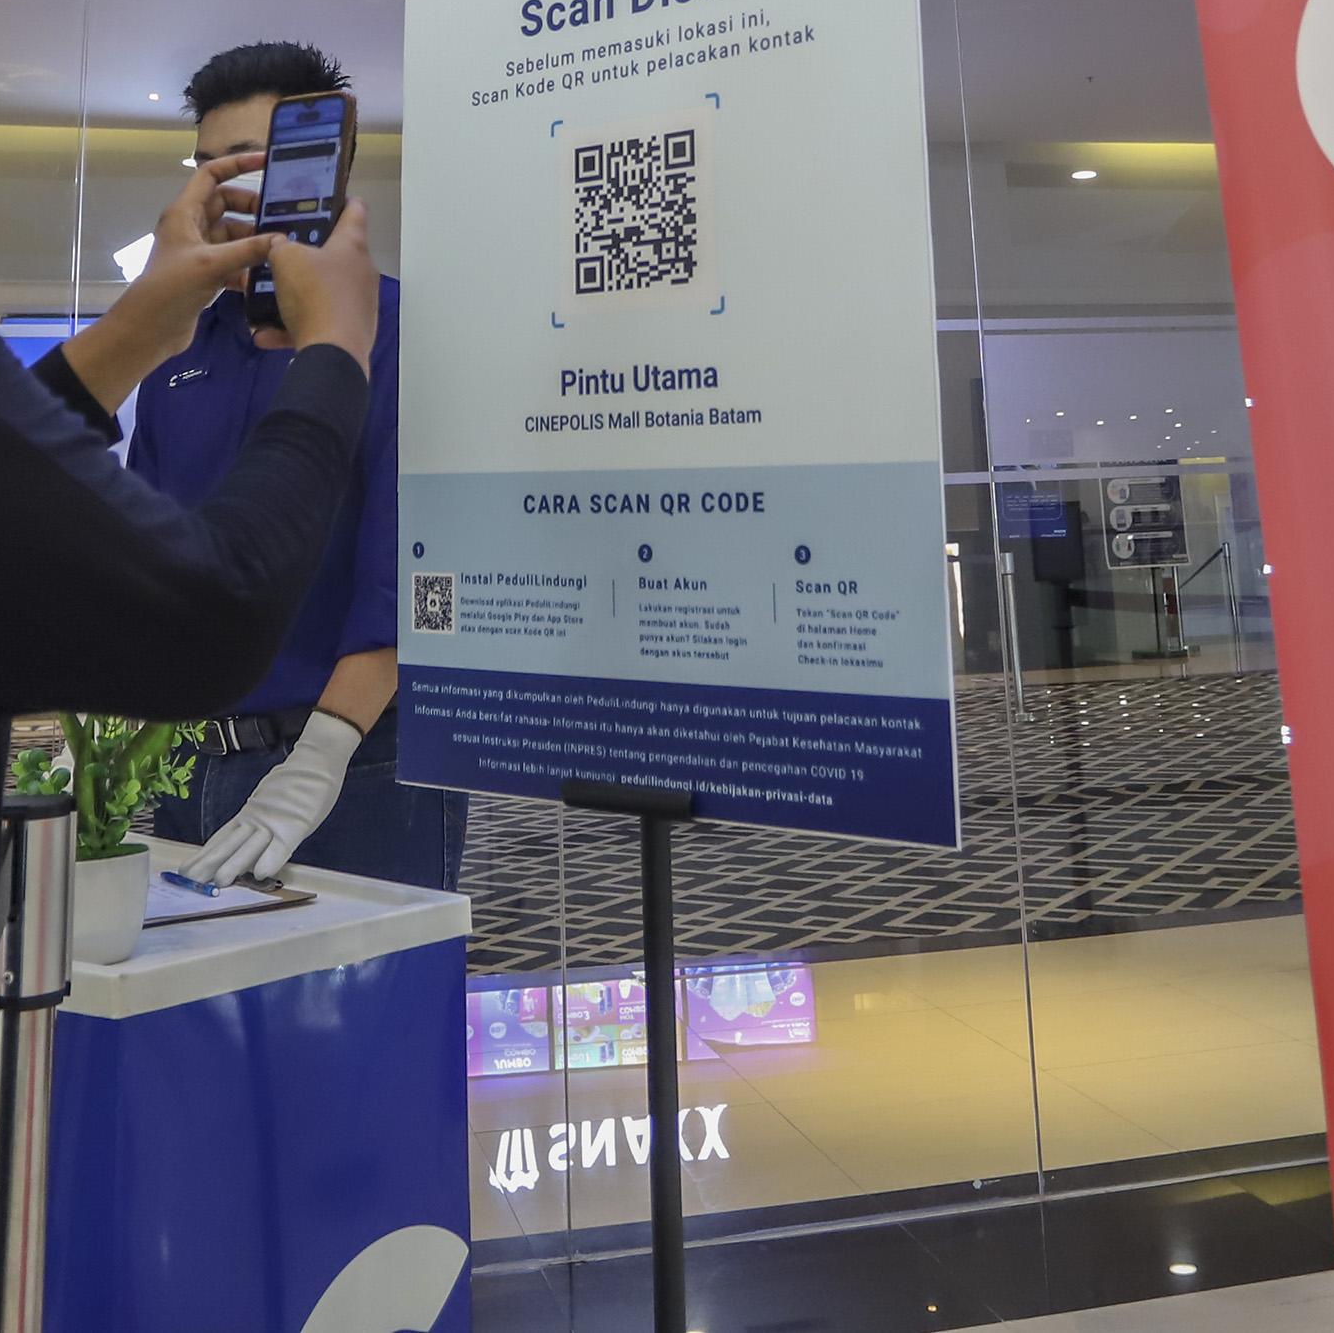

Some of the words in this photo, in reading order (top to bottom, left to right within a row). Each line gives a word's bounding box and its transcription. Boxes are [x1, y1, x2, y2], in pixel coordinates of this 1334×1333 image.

[506, 50, 574, 77] Sebelum
[582, 29, 670, 62] memasuki
[678, 16, 733, 43] lokasi
[742, 9, 770, 29] ini,
[471, 88, 509, 107] Scan
[516, 79, 555, 99] Kode
[562, 71, 584, 90] QR
[591, 61, 639, 83] untuk
[647, 42, 740, 77] pelacakan
[748, 25, 815, 53] kontak
[561, 368, 624, 397] Pintu
[633, 363, 718, 392] Utama
[524, 413, 604, 433] CINEPOLIS
[608, 410, 640, 429] Mall
[644, 408, 704, 428] Botania
[709, 407, 762, 425] Batam
[523, 494, 580, 514] CARA
[589, 493, 649, 513] SCAN
[660, 493, 691, 516] QR
[701, 491, 765, 513] CODE
[461, 573, 492, 585] Instal
[497, 574, 587, 590] PeduliLindungi
[639, 577, 668, 590] Buat
[674, 577, 707, 591] Akun
[796, 580, 831, 593] Scan
[838, 581, 858, 595] QR
[412, 682, 439, 694] Semua
[441, 684, 481, 697] informasi
[483, 688, 503, 701] yang
[506, 690, 561, 704] dikumpulkan
[564, 695, 584, 706] oleh
[660, 701, 690, 715] hanya
[693, 703, 746, 718] digunakan
[749, 708, 779, 721] untuk
[783, 710, 817, 724] tujuan
[820, 714, 878, 728] pelacakan
[414, 705, 453, 718] Informasi
[456, 709, 477, 720] Anda
[479, 710, 513, 723] bersifat
[553, 718, 597, 731] Informasi
[615, 723, 644, 736] hanya
[647, 726, 670, 737] akan
[673, 728, 720, 742] diketahui
[723, 732, 745, 744] oleh
[749, 734, 789, 749] Pejabat
[792, 738, 851, 753] Kesehatan
[855, 742, 922, 759] Masyarakat
[479, 758, 521, 771] Informasi
[523, 762, 544, 773] lebih
[547, 765, 573, 778] lanjut
[482, 734, 519, 747] Instruksi
[522, 738, 561, 752] Presiden
[564, 743, 606, 757] (INPRES)
[609, 747, 646, 762] tentang
[649, 751, 716, 768] pengendalian
[720, 757, 738, 769] dan
[742, 760, 807, 776] pencegahan
[811, 766, 846, 780] COVID
[851, 769, 864, 781] 19
